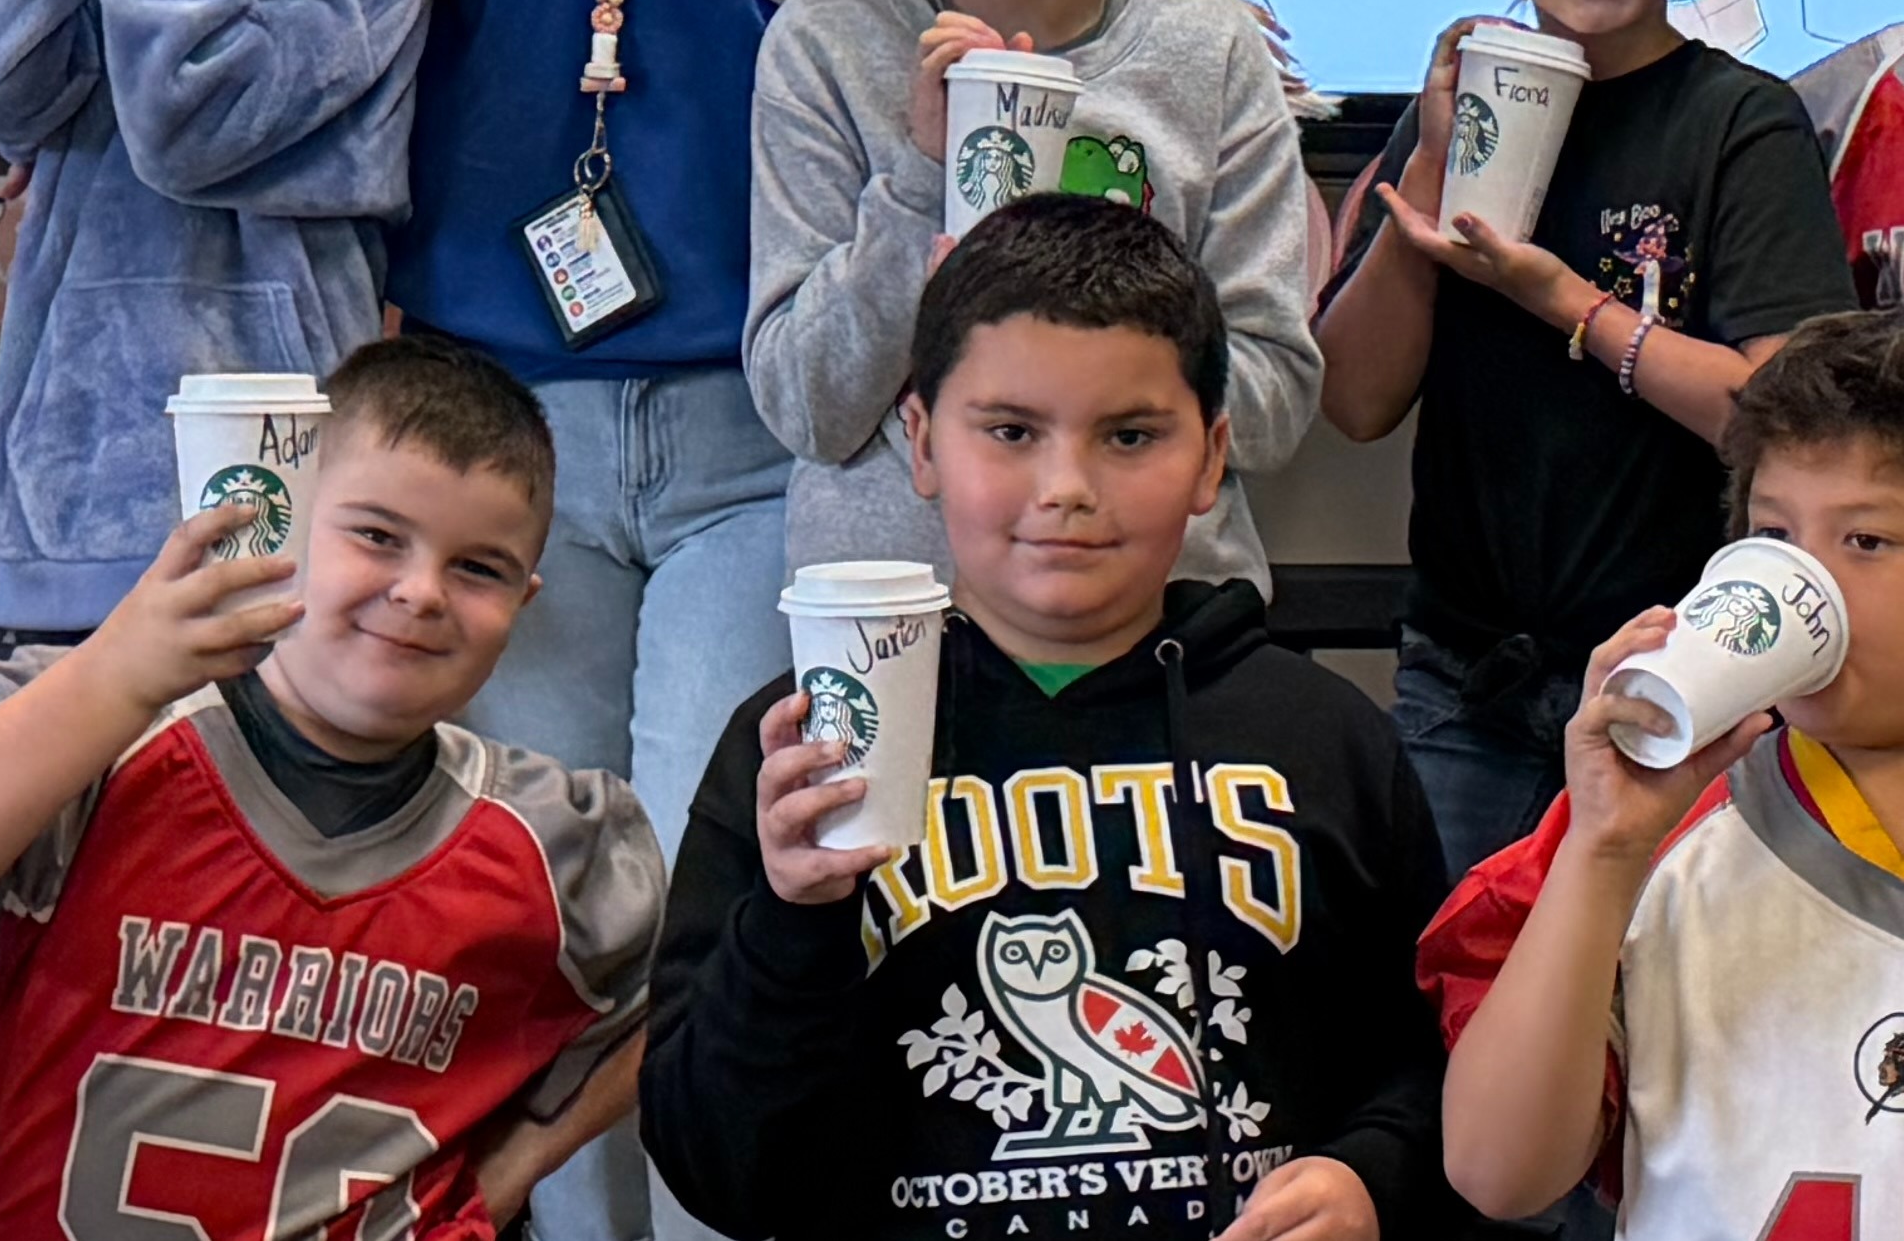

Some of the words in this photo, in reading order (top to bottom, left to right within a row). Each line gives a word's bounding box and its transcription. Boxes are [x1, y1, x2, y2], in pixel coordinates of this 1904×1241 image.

[1493, 66, 1551, 108] Fiona
[1782, 572, 1833, 657] John
[112, 912, 480, 1074] WARRIORS
[892, 1161, 1109, 1210] OCTOBER'S
